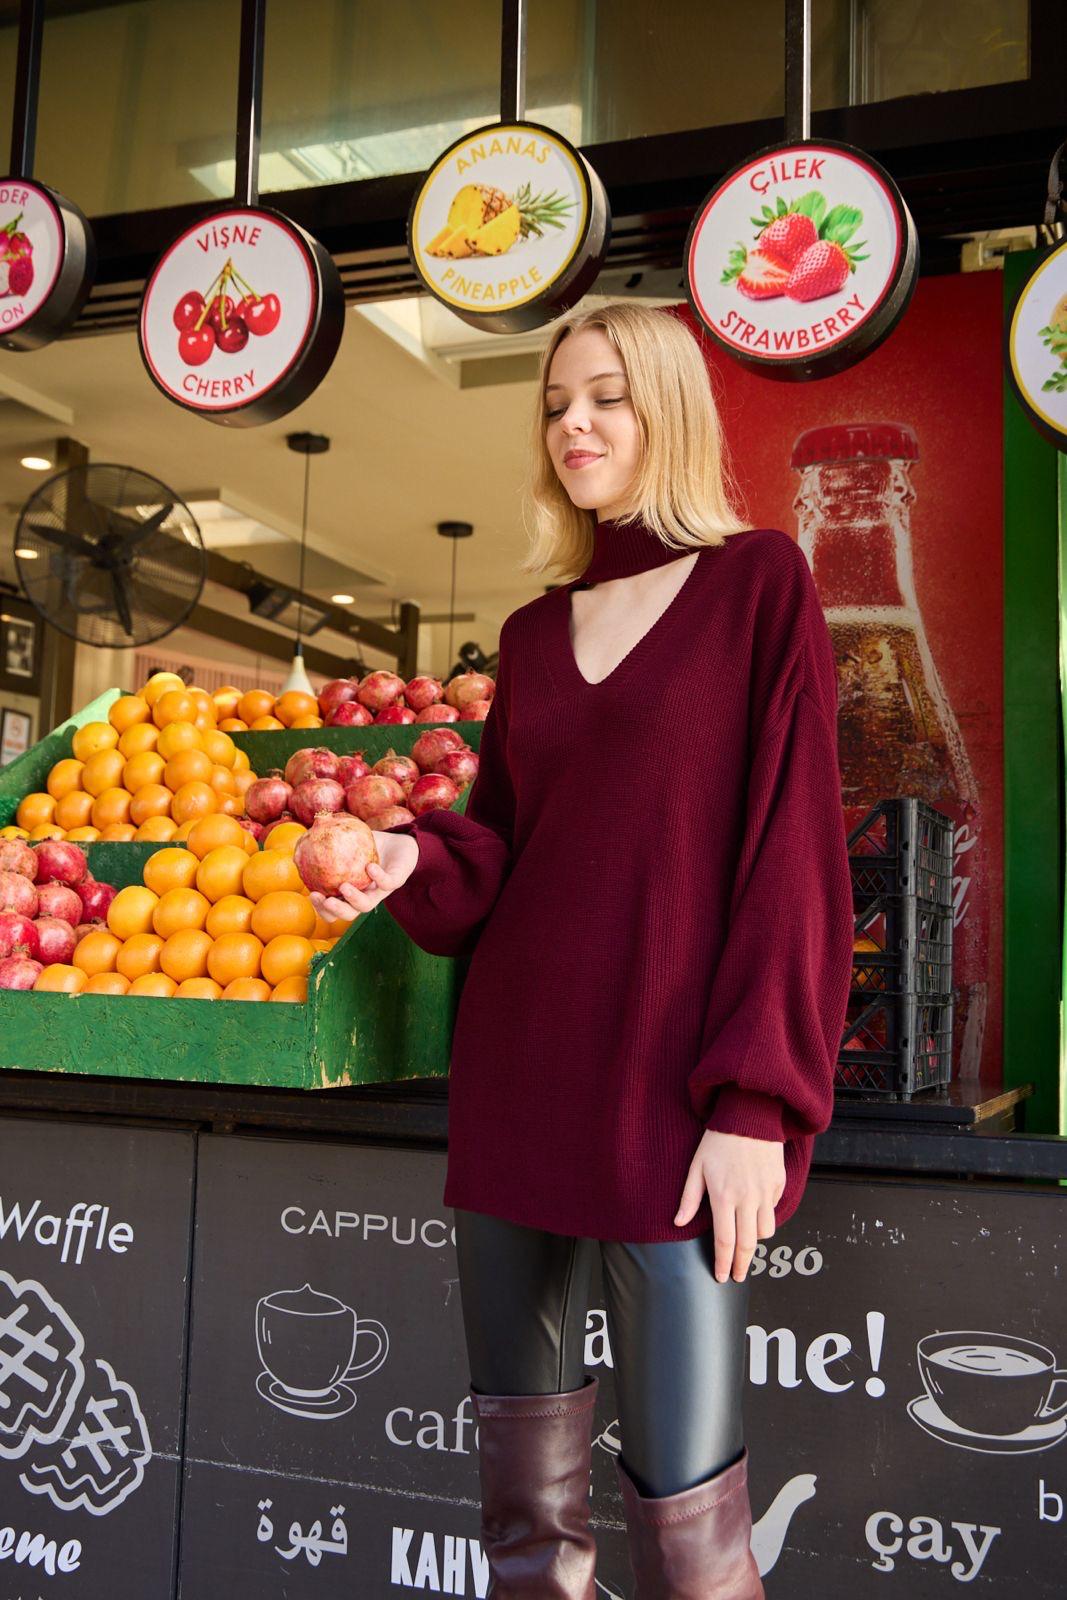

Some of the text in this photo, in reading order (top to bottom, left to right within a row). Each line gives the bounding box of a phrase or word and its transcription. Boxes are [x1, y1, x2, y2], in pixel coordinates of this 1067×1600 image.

[456, 137, 551, 175] ANANAS
[750, 158, 825, 194] ÇİLEK
[197, 226, 261, 253] VİŞNE
[441, 266, 542, 300] PINEAPPLE
[720, 294, 866, 350] STRAWBERRY
[183, 369, 256, 397] CHERRY
[0, 1196, 134, 1264] Waffle
[280, 1206, 457, 1248] CAPPUC
[385, 1396, 479, 1454] caf
[257, 1498, 348, 1567] قهوة
[865, 1511, 1001, 1582] çay
